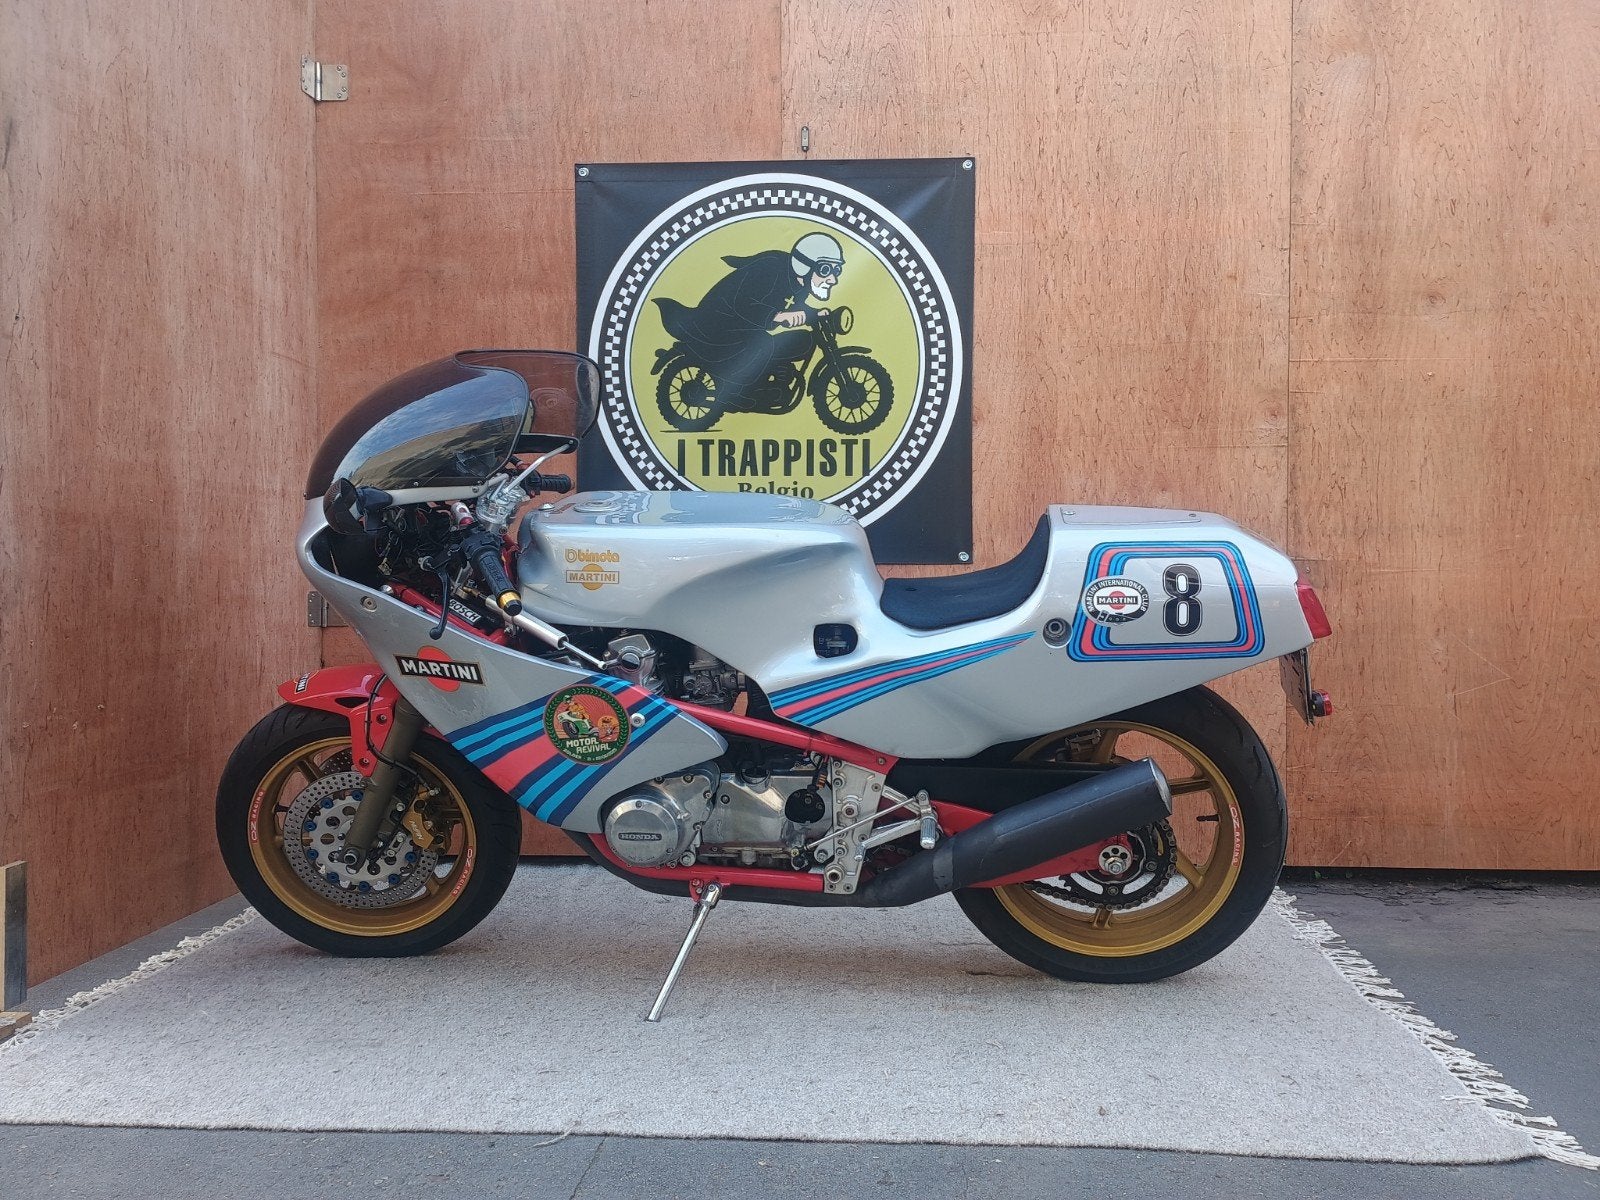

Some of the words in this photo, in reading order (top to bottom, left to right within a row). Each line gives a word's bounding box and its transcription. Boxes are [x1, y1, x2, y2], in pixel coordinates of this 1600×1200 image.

[677, 438, 686, 477] I
[697, 438, 871, 477] TRAPPISTI
[569, 572, 616, 582] MARTINI
[1097, 579, 1145, 593] INTERNATIONAL
[1098, 596, 1136, 604] MARTINI
[1162, 563, 1203, 636] 8
[401, 659, 478, 681] MARTINI
[566, 737, 599, 748] MOTOR
[576, 743, 611, 754] REVIVAL
